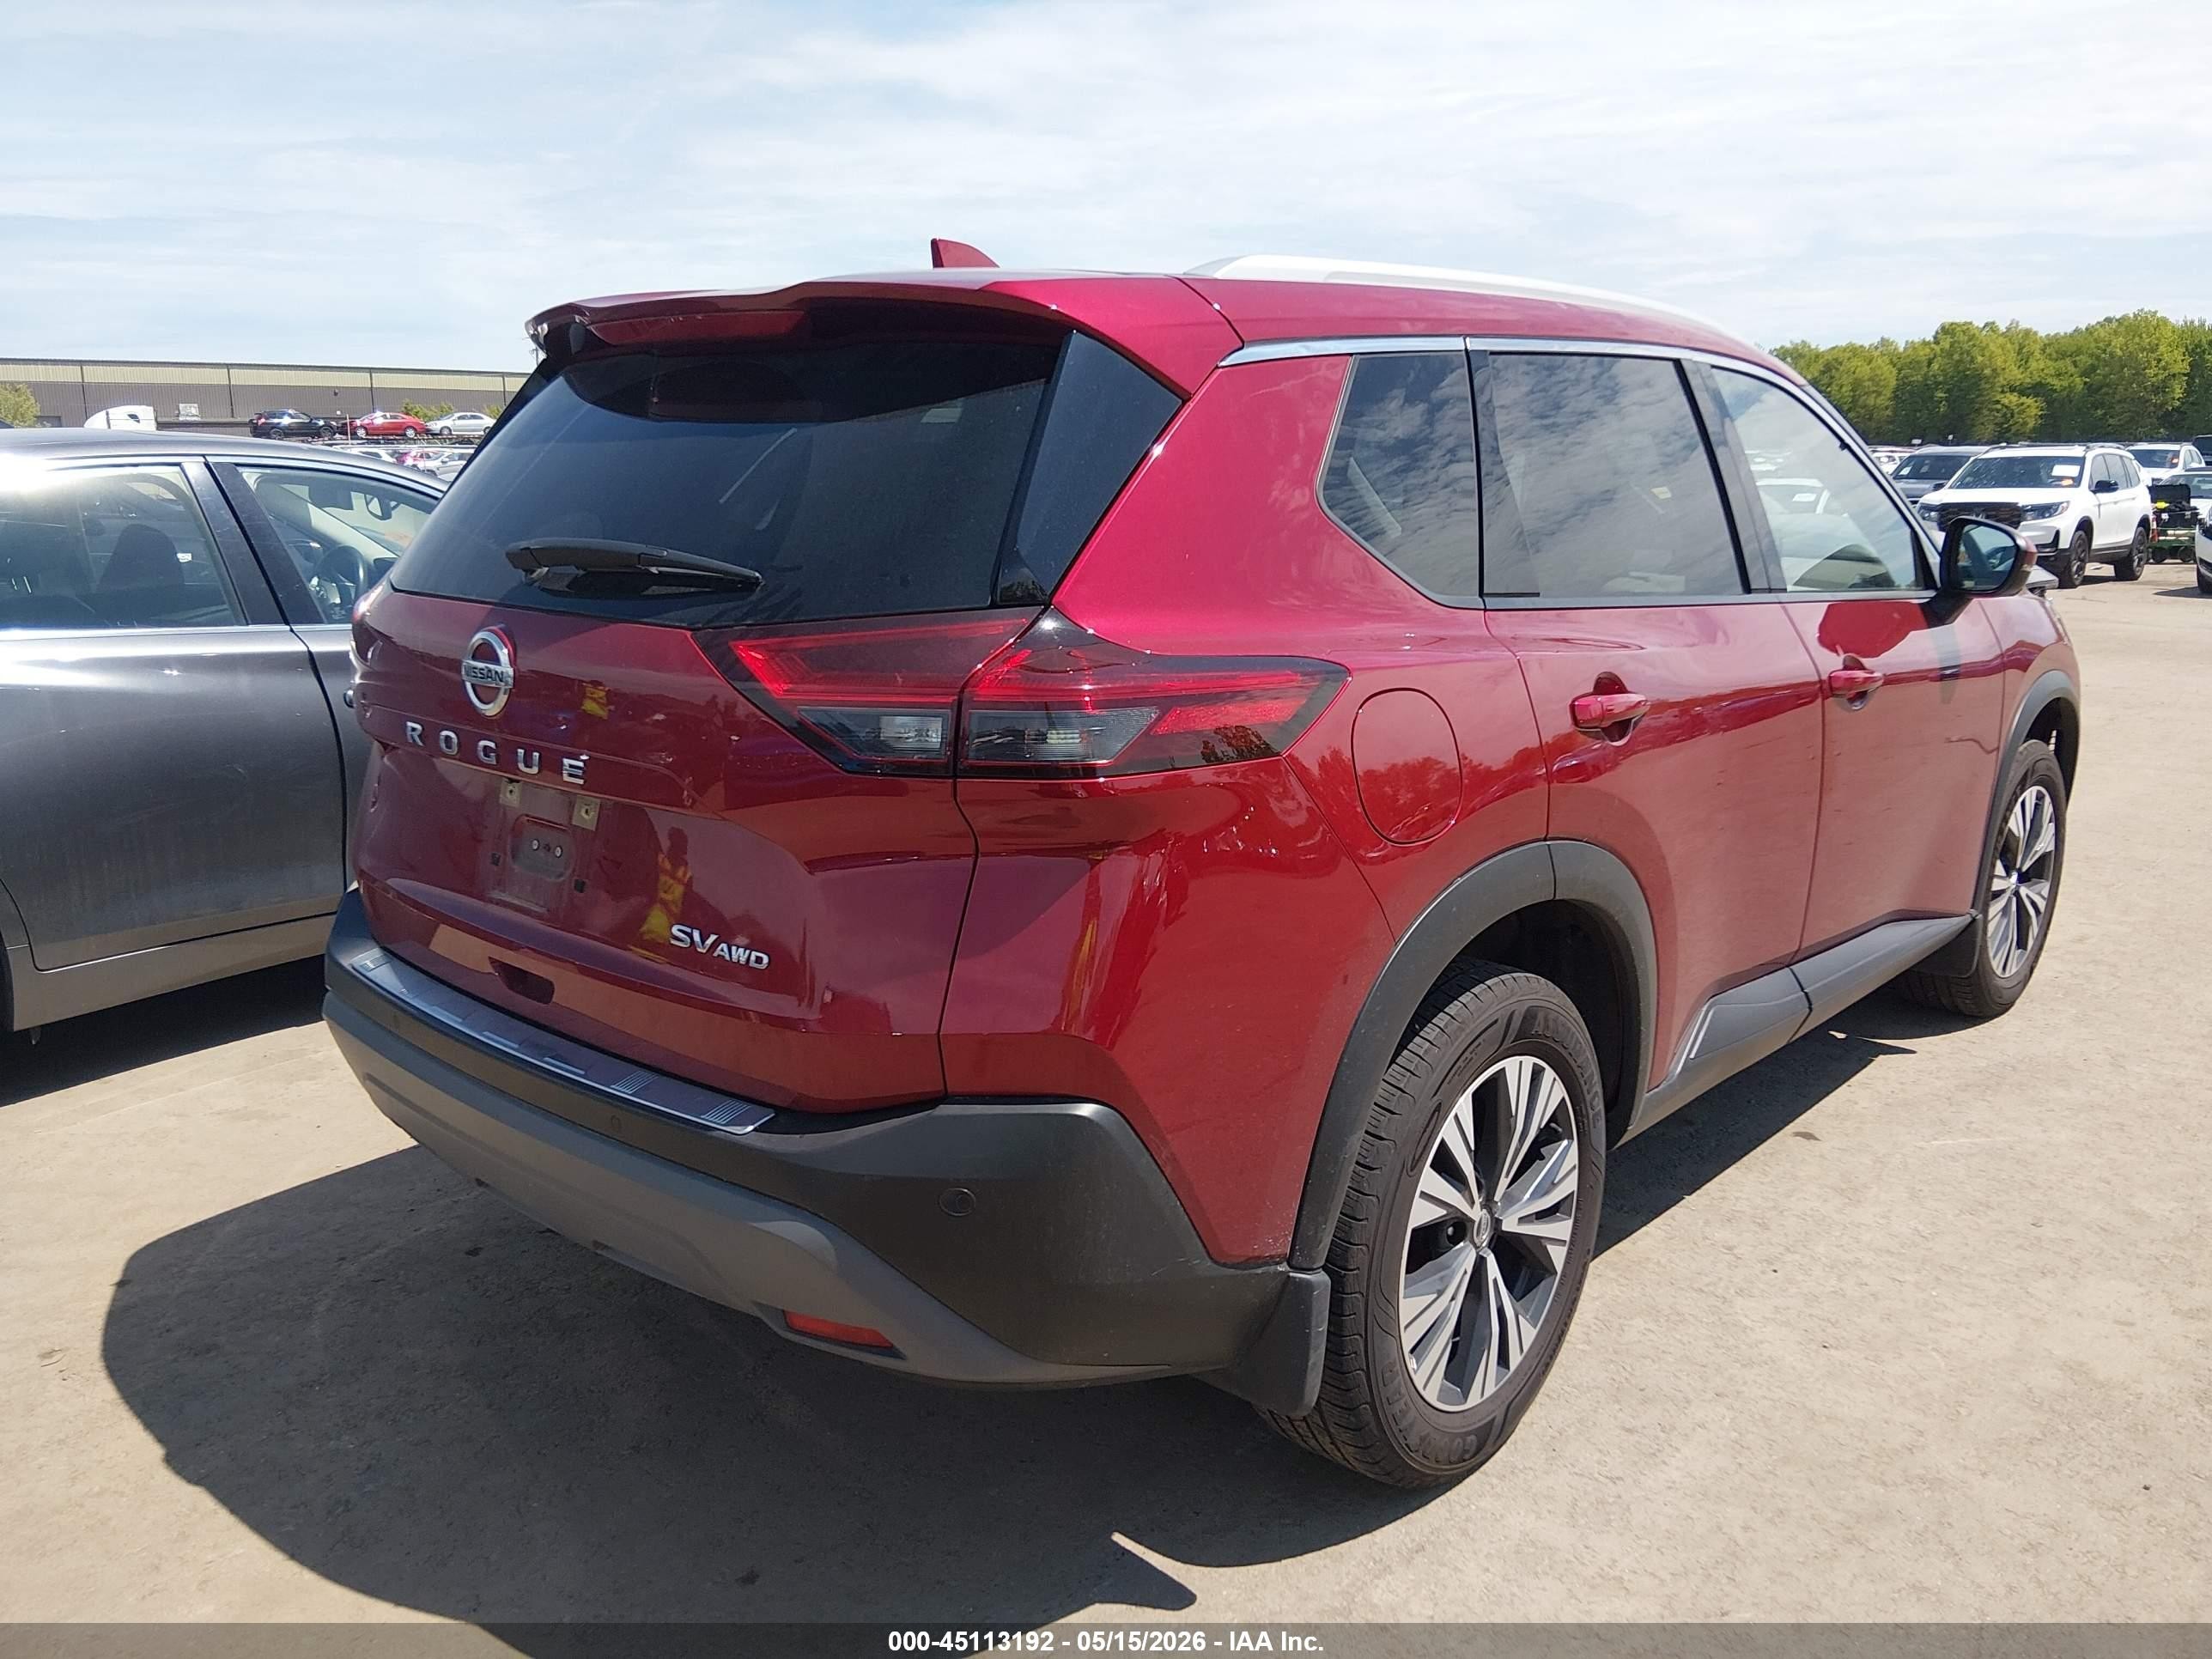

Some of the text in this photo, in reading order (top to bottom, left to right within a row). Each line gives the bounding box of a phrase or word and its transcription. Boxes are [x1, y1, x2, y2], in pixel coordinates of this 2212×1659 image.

[464, 665, 504, 683] NISSAN
[406, 721, 585, 785] ROGUE
[670, 924, 769, 969] SV AWD
